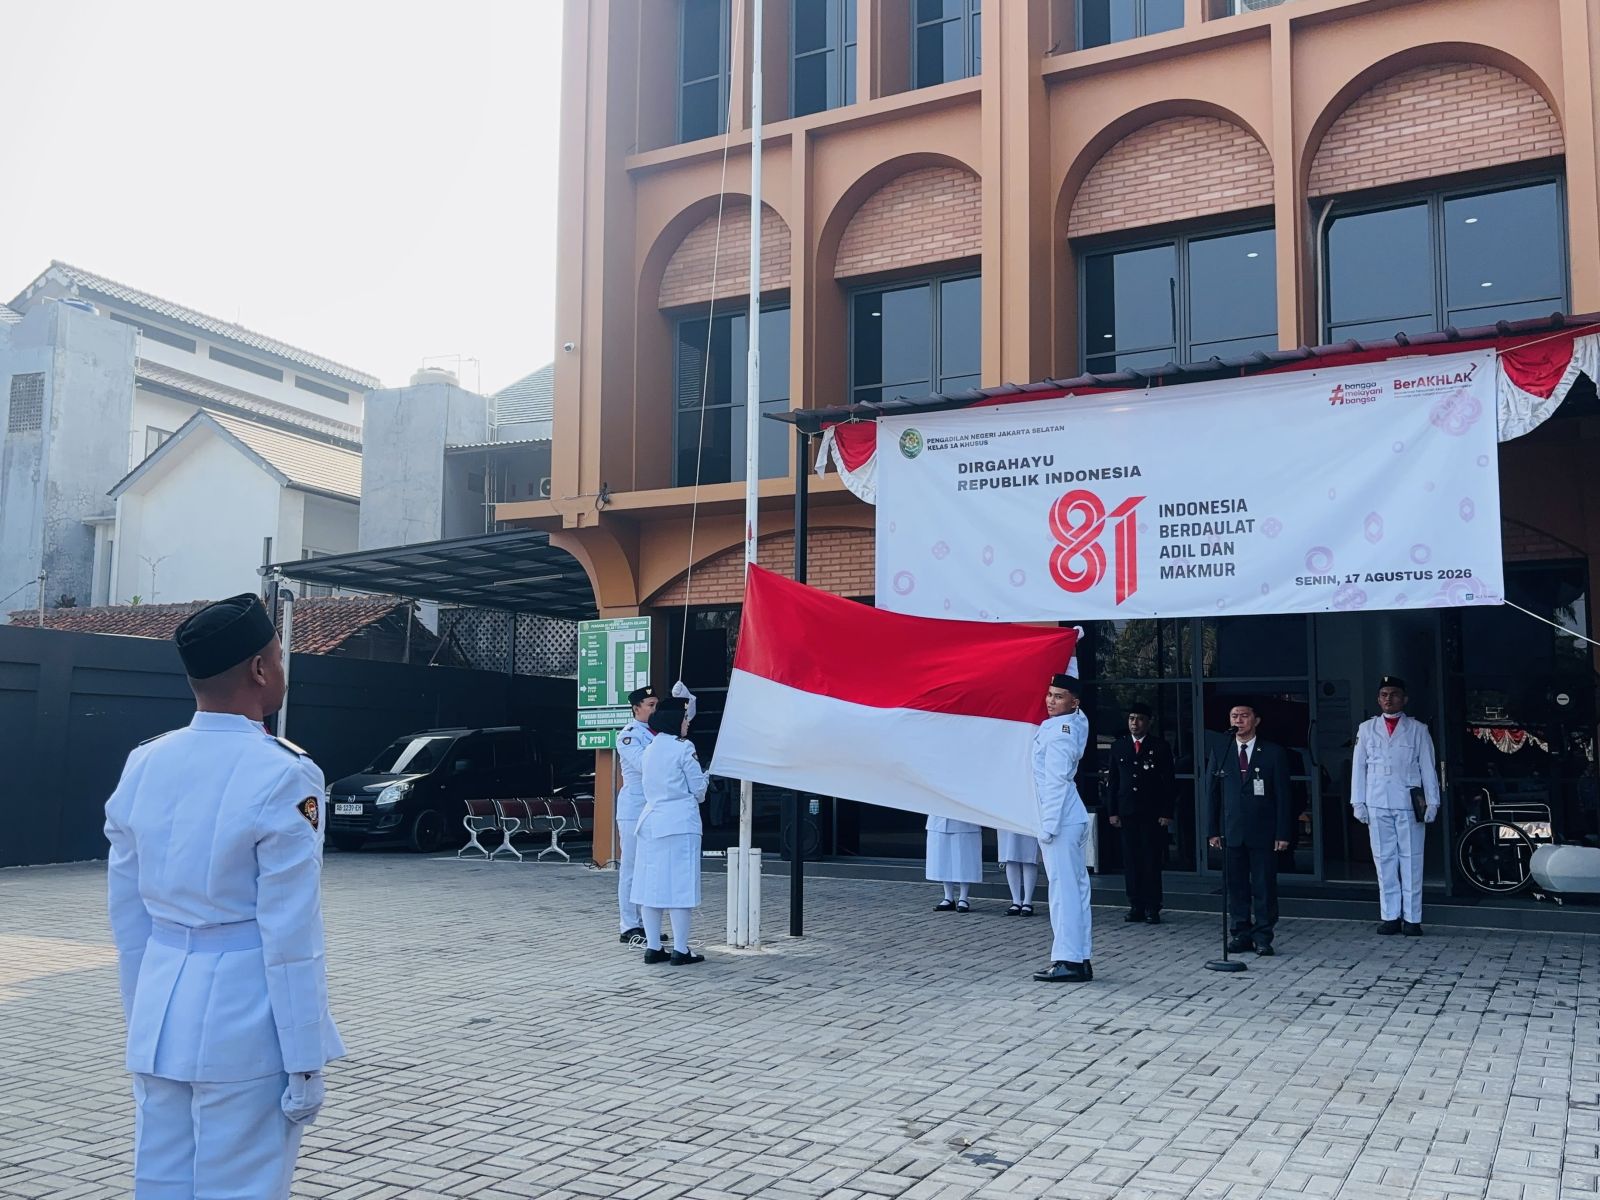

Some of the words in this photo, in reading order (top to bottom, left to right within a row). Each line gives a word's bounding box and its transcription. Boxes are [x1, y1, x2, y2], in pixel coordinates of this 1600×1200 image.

[1344, 382, 1377, 390] bangga
[1393, 371, 1473, 390] BerAKHLAK
[1344, 387, 1383, 397] melayani
[1345, 396, 1376, 405] bangsa
[926, 434, 970, 444] PENGADILAN
[970, 432, 996, 440] NEGERI
[997, 429, 1031, 437] JAKARTA
[1031, 425, 1065, 434] SELATAN
[927, 443, 949, 451] KELAS
[959, 440, 989, 448] KHUSUS
[958, 454, 1055, 474] DIRGAHAYU
[957, 474, 1039, 491] REPUBLIK
[1045, 465, 1142, 484] INDONESIA
[1159, 498, 1248, 518] INDONESIA
[1159, 519, 1256, 538] BERDAULAT
[1048, 489, 1148, 606] 81
[1159, 544, 1196, 559] ADIL
[1200, 541, 1235, 557] DAN
[1160, 562, 1236, 580] MAKMUR
[1295, 575, 1341, 587] SENIN,
[1345, 574, 1360, 583] 17
[1364, 570, 1433, 583] AGUSTUS
[1437, 568, 1472, 579] 2026
[589, 736, 607, 744] PTSP
